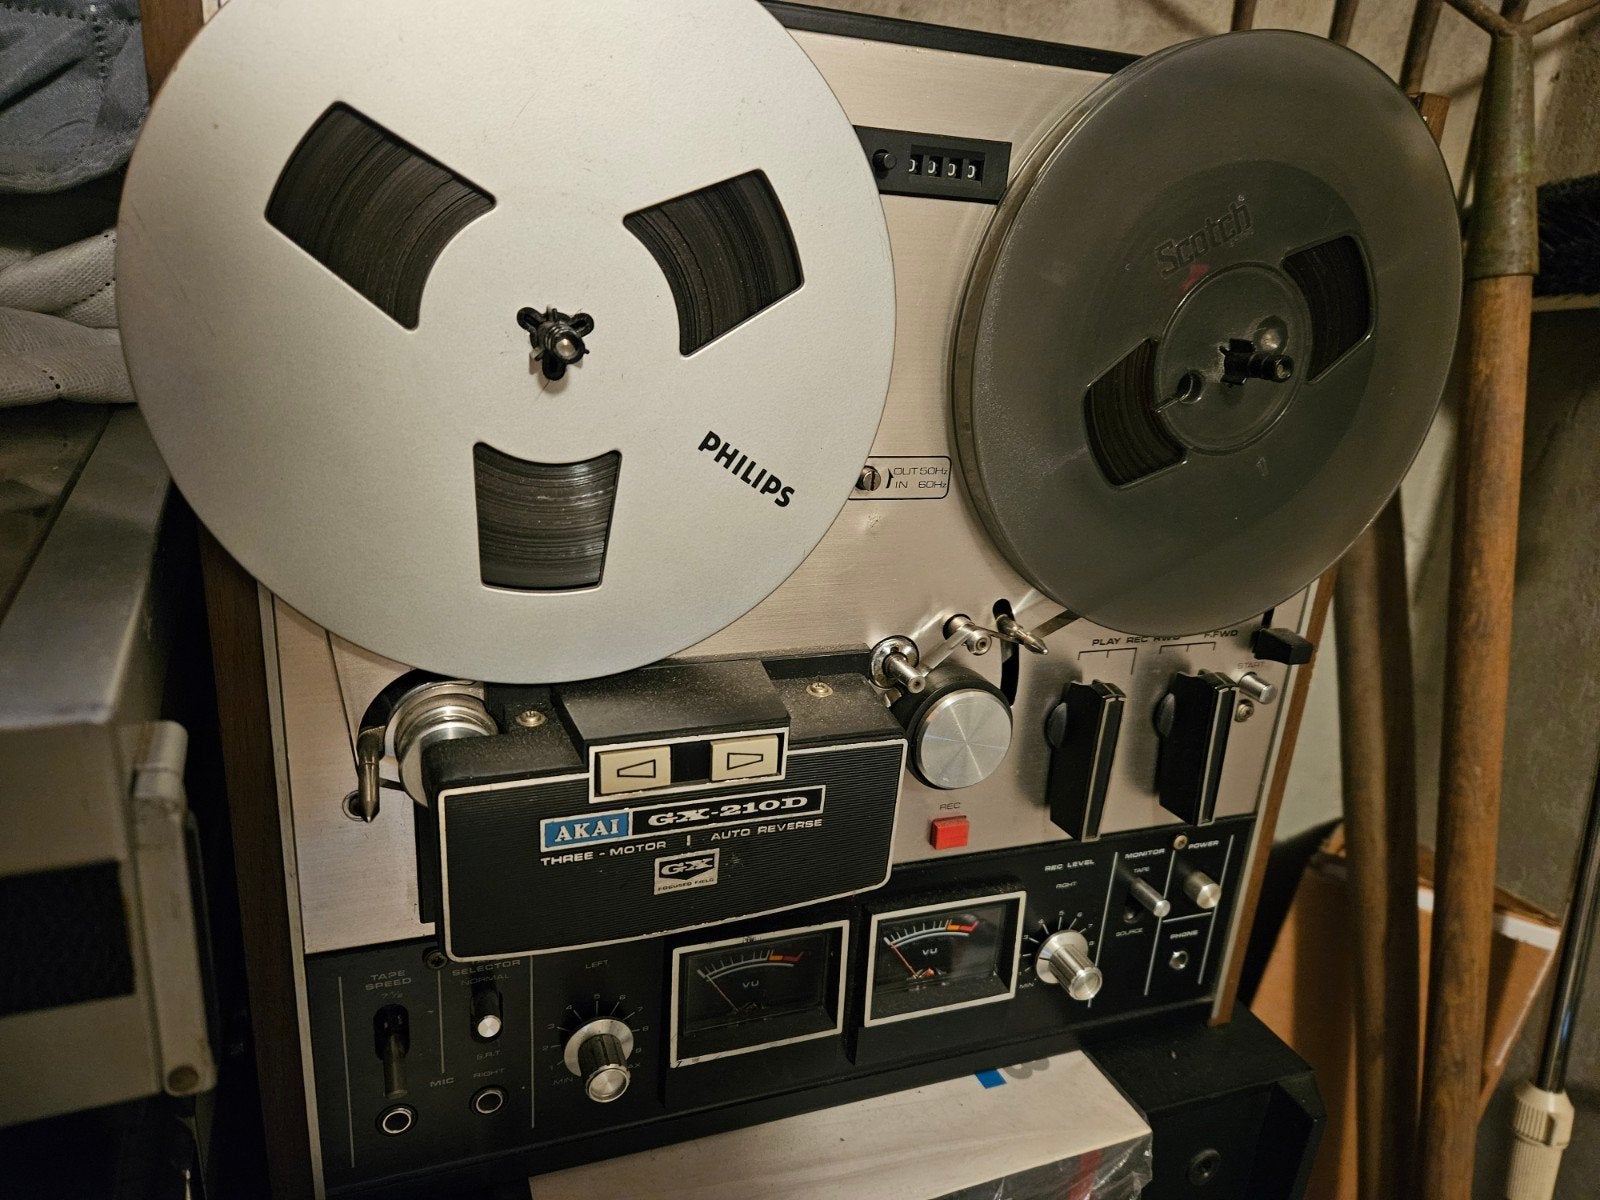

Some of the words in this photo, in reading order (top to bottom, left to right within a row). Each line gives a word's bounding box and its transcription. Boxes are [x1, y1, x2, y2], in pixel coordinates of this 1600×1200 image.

[1154, 202, 1253, 279] Scotch
[697, 430, 795, 508] PHILIPS
[893, 467, 919, 476] OUT
[919, 466, 949, 476] 50Hz
[895, 480, 908, 489] IN
[918, 480, 948, 489] 60Hz
[1092, 637, 1121, 647] PLAY
[1237, 662, 1265, 670] START
[647, 796, 809, 827] GX-210D
[939, 801, 961, 811] REC
[554, 818, 620, 843] AKAI
[710, 827, 751, 842] AUTO
[756, 818, 823, 836] REVERSE
[1188, 839, 1220, 850] POWER
[540, 851, 594, 867] THREE
[609, 840, 667, 857] MOTOR
[1124, 848, 1166, 859] MONITOR
[660, 857, 714, 876] GX
[1044, 863, 1064, 872] REC
[1067, 859, 1096, 868] LEVEL
[657, 881, 692, 892] FOCUSED
[1055, 880, 1079, 889] RIGHT
[1115, 927, 1143, 937] SOURCE
[1169, 929, 1199, 940] PHONE
[923, 947, 938, 956] VU
[452, 959, 521, 977] SELECTOR
[585, 959, 609, 969] LEFT
[369, 969, 406, 981] TAPE
[461, 973, 510, 986] NORMAL
[365, 977, 412, 991] SPEED
[742, 979, 760, 989] VU
[473, 1067, 506, 1078] RIGHT
[429, 1077, 455, 1088] MIC
